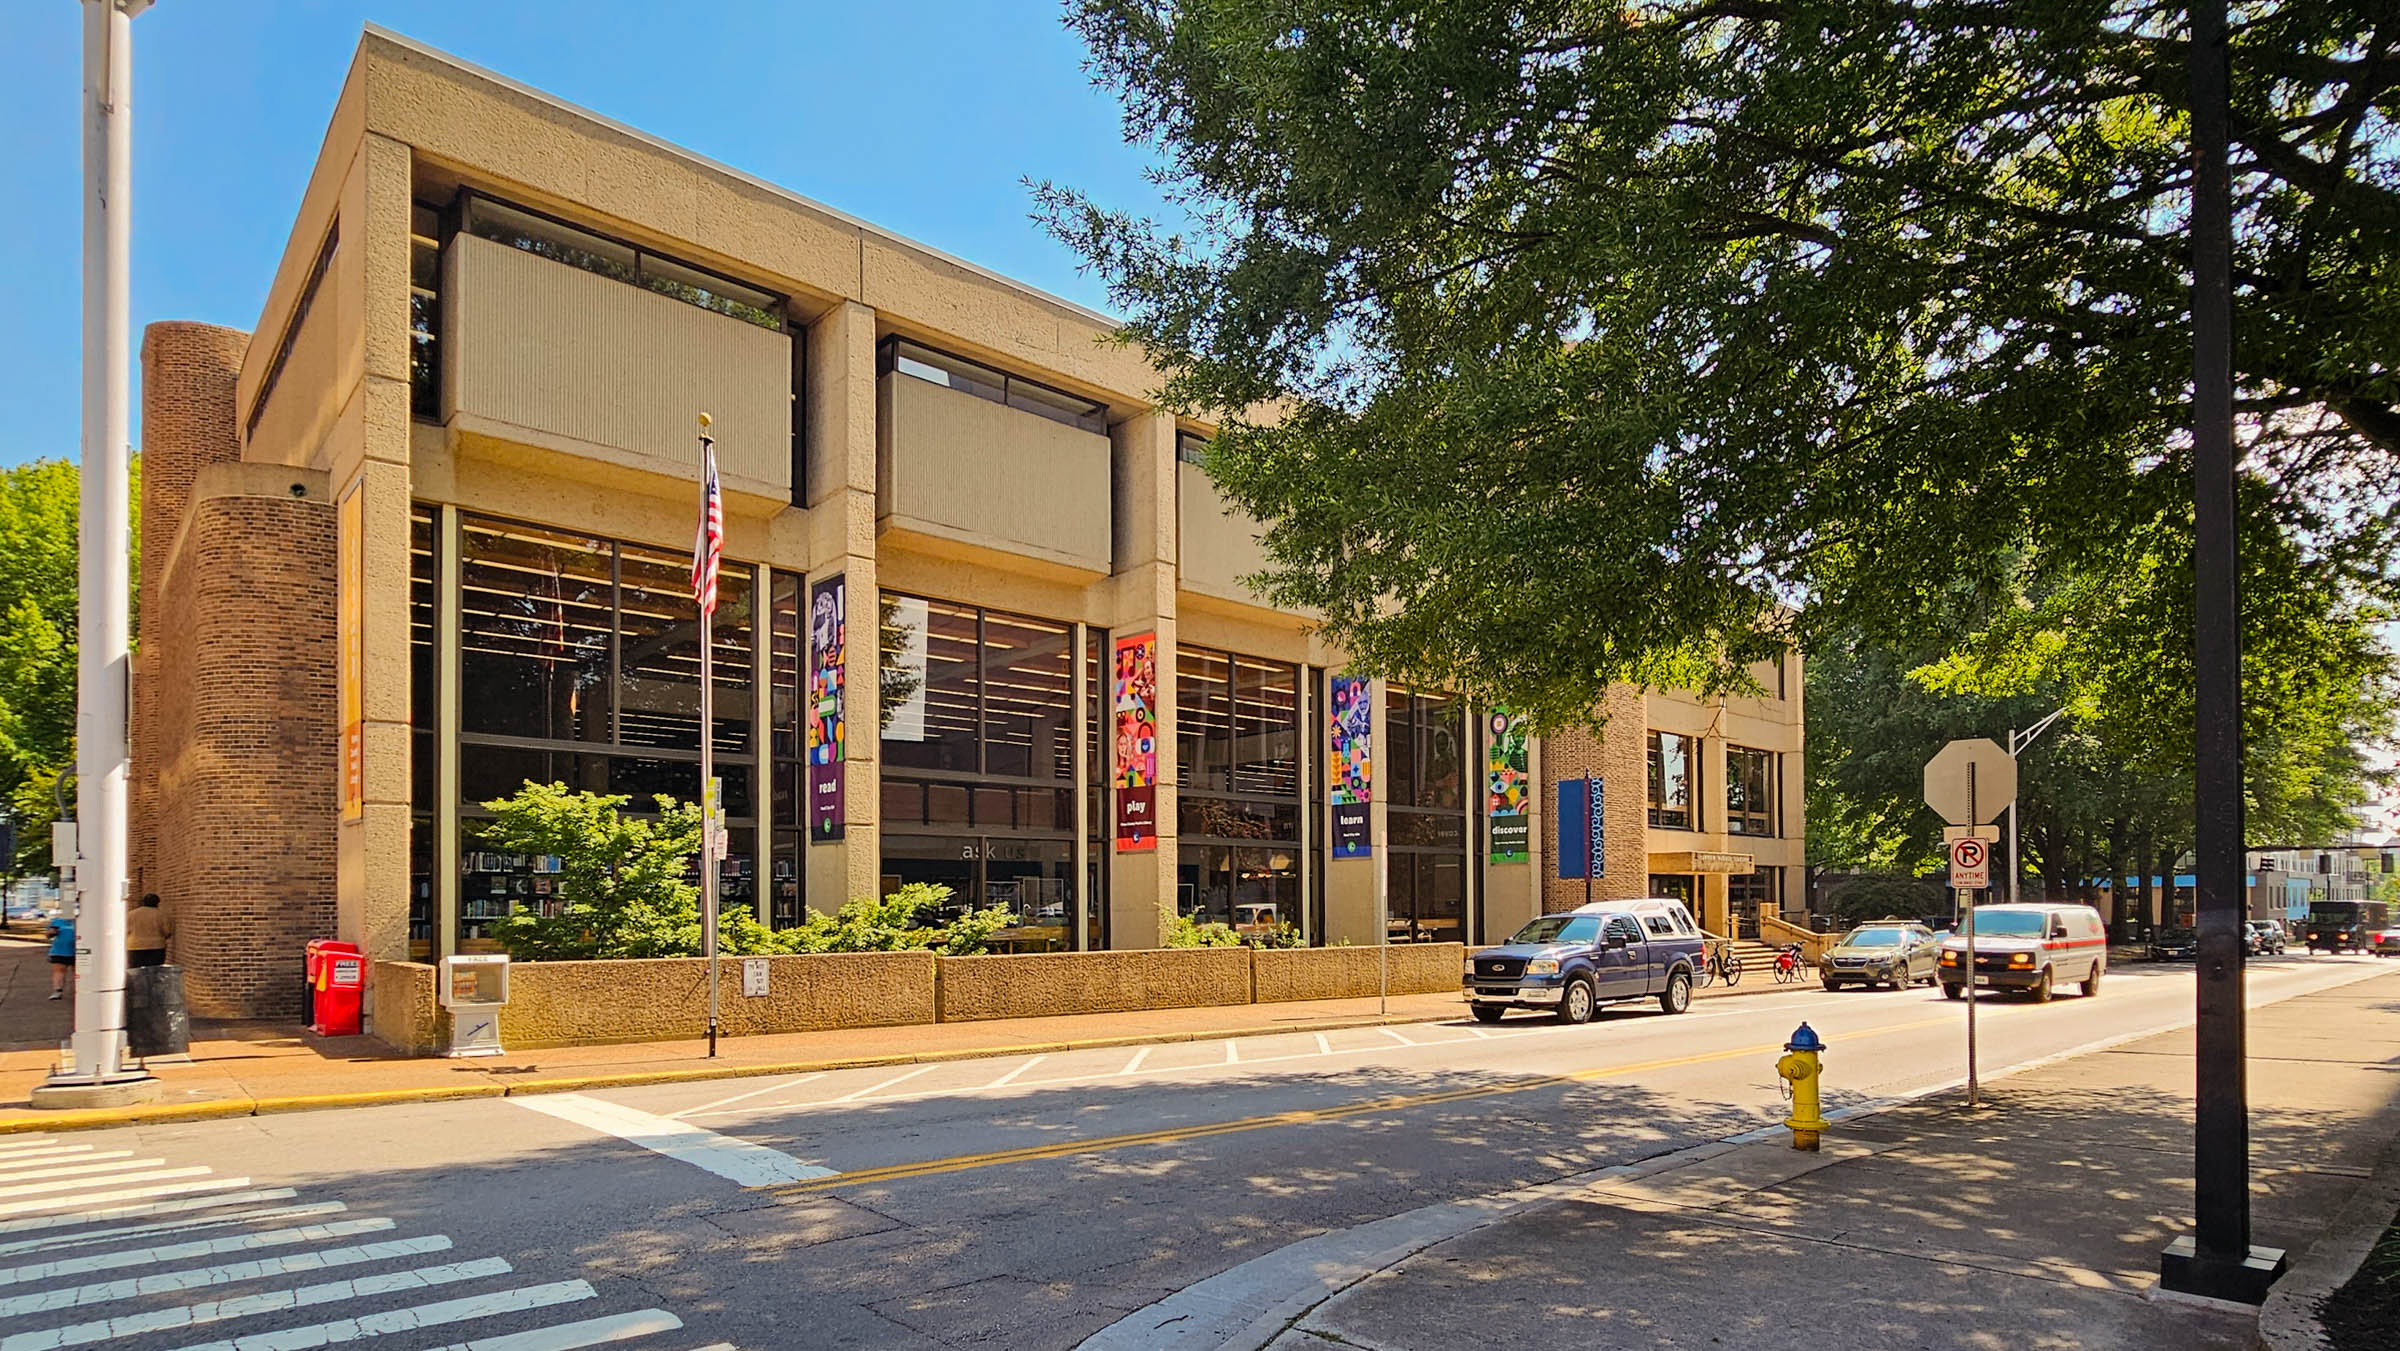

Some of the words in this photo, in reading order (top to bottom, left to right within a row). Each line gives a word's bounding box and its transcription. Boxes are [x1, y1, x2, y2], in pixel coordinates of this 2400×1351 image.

[819, 778, 837, 794] read
[1126, 800, 1146, 814] play
[1340, 815, 1364, 825] learn
[1492, 825, 1528, 835] discover
[1955, 872, 1985, 880] ANYTIME
